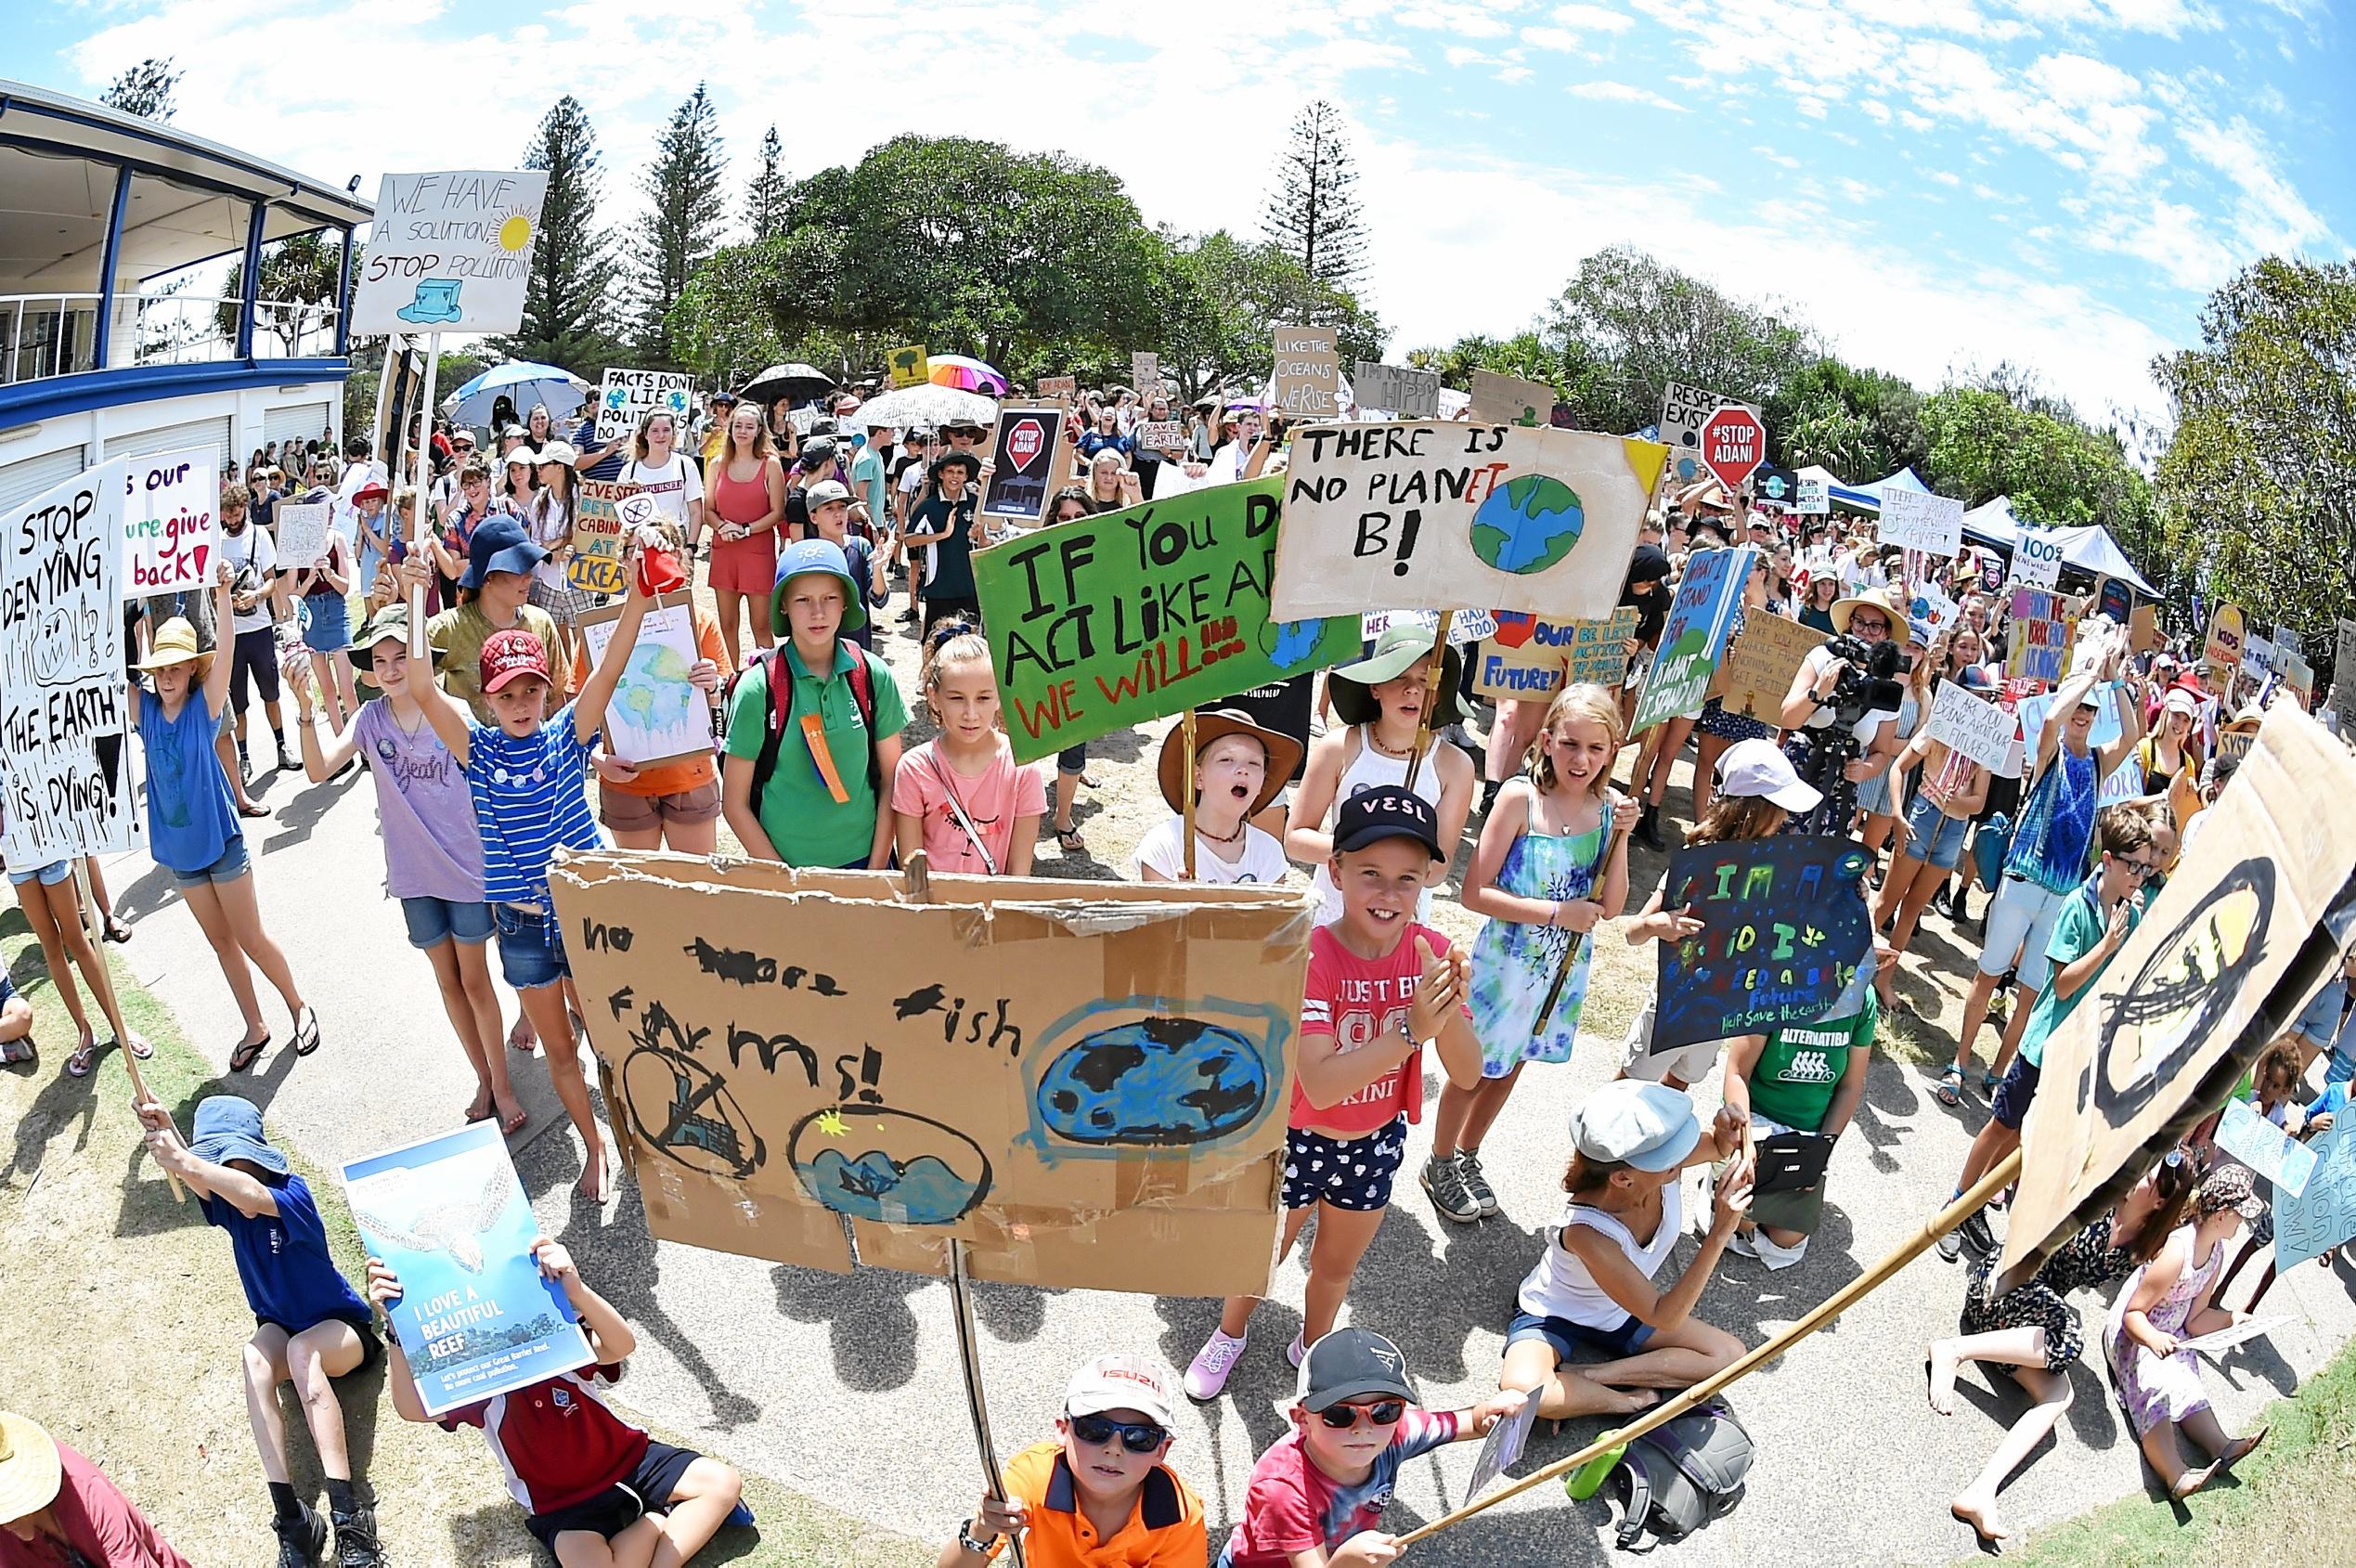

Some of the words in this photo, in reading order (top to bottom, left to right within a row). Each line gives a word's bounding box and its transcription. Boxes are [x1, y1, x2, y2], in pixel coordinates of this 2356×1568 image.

[393, 175, 439, 214] WE
[442, 175, 517, 211] HAVE
[375, 220, 391, 242] A
[369, 254, 439, 281] STOP
[1276, 339, 1308, 352] LIKE
[1309, 341, 1330, 352] THE
[608, 372, 654, 386] FACTS
[1276, 359, 1332, 379] OCEANS
[630, 389, 667, 404] LIE
[1276, 385, 1300, 411] WE
[1300, 383, 1334, 412] RISE
[598, 427, 615, 439] DO
[1015, 430, 1039, 441] #STOP
[1145, 423, 1177, 432] SAVE
[1146, 434, 1181, 447] EARTH
[1712, 425, 1755, 444] #STOP
[1012, 442, 1037, 453] ADANI
[1302, 427, 1434, 462] THERE
[1464, 427, 1508, 453] IS
[1713, 445, 1753, 463] ADANI
[146, 463, 190, 491] our
[583, 481, 614, 499] I'VE
[1290, 474, 1348, 505] NO
[1368, 462, 1510, 504] PLANET
[19, 490, 94, 555] STOP
[159, 508, 211, 558] give
[589, 539, 615, 554] AT
[1353, 509, 1421, 577] B!
[2023, 537, 2064, 562] 100%
[134, 545, 210, 586] back!
[573, 559, 625, 588] IKEA
[1008, 535, 1096, 624] IF
[1125, 508, 1218, 571] YOU
[1685, 554, 1718, 585] WHAT
[1714, 554, 1728, 581] I
[3, 538, 101, 630] DENYING
[1676, 585, 1711, 614] STAND
[1005, 604, 1095, 687] ACT
[1114, 573, 1211, 655] LIKE
[1366, 616, 1391, 634] HER
[1464, 621, 1492, 638] TOO
[1534, 622, 1574, 647] OUR
[1746, 623, 1767, 639] LIKE
[2217, 628, 2239, 651] KIDS
[1483, 655, 1560, 691] FUTURE!
[1736, 654, 1773, 674] NOTHING
[1015, 680, 1084, 739] WE
[1640, 696, 1653, 723] I
[1650, 680, 1689, 719] STAND
[5, 706, 40, 755] THE
[48, 685, 117, 744] EARTH
[16, 787, 37, 823] IS
[584, 917, 633, 953] no
[1335, 978, 1392, 1004] JUST
[1780, 1028, 1850, 1047] ALTERNATIBA
[413, 1306, 422, 1321] I
[423, 1289, 462, 1318] LOVE
[466, 1285, 479, 1302] A
[421, 1299, 504, 1341] BEAUTIFUL
[428, 1333, 465, 1360] REEF
